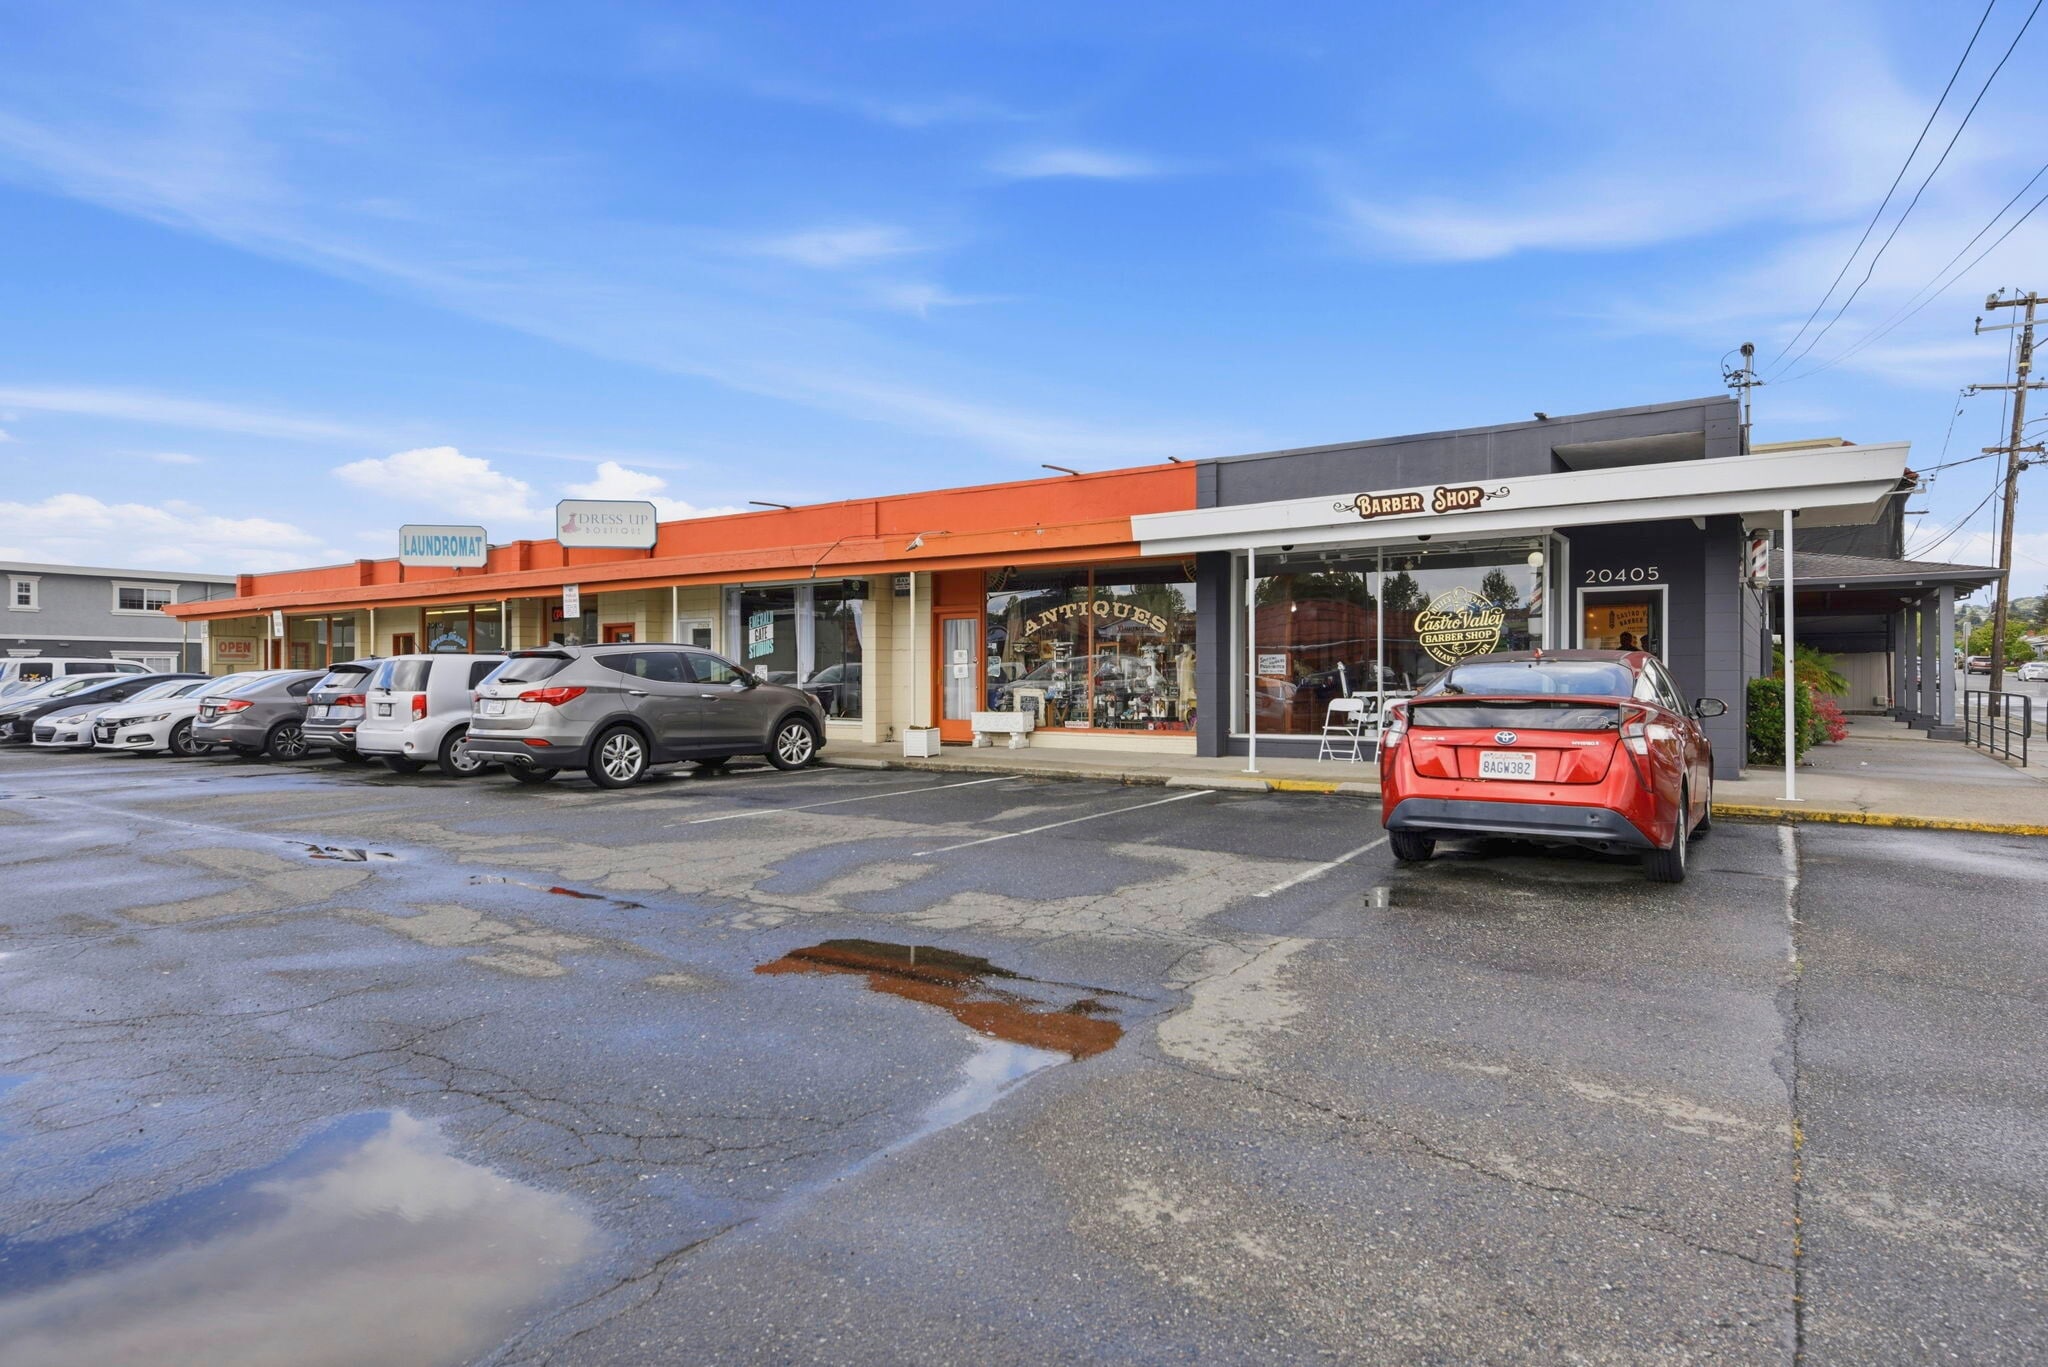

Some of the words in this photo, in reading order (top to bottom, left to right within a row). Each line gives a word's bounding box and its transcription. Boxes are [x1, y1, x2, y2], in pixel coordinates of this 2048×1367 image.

[1356, 495, 1421, 516] BARBER
[1434, 489, 1480, 511] SHOP
[579, 513, 623, 525] DRESS
[629, 514, 648, 525] UP
[404, 535, 483, 557] LAUNDROMAT
[1585, 566, 1660, 583] 20405
[749, 611, 774, 630] EMERALD
[1024, 600, 1168, 637] ANTIQUES
[1414, 610, 1462, 632] Castro
[1457, 607, 1506, 631] Valley
[754, 627, 768, 641] GATE
[1425, 632, 1464, 643] BARBER
[1465, 630, 1492, 640] SHOP
[218, 641, 252, 653] OPEN
[749, 639, 774, 659] STUDIOS
[1431, 646, 1457, 663] SHAVE
[1483, 760, 1531, 775] 8AGW382
